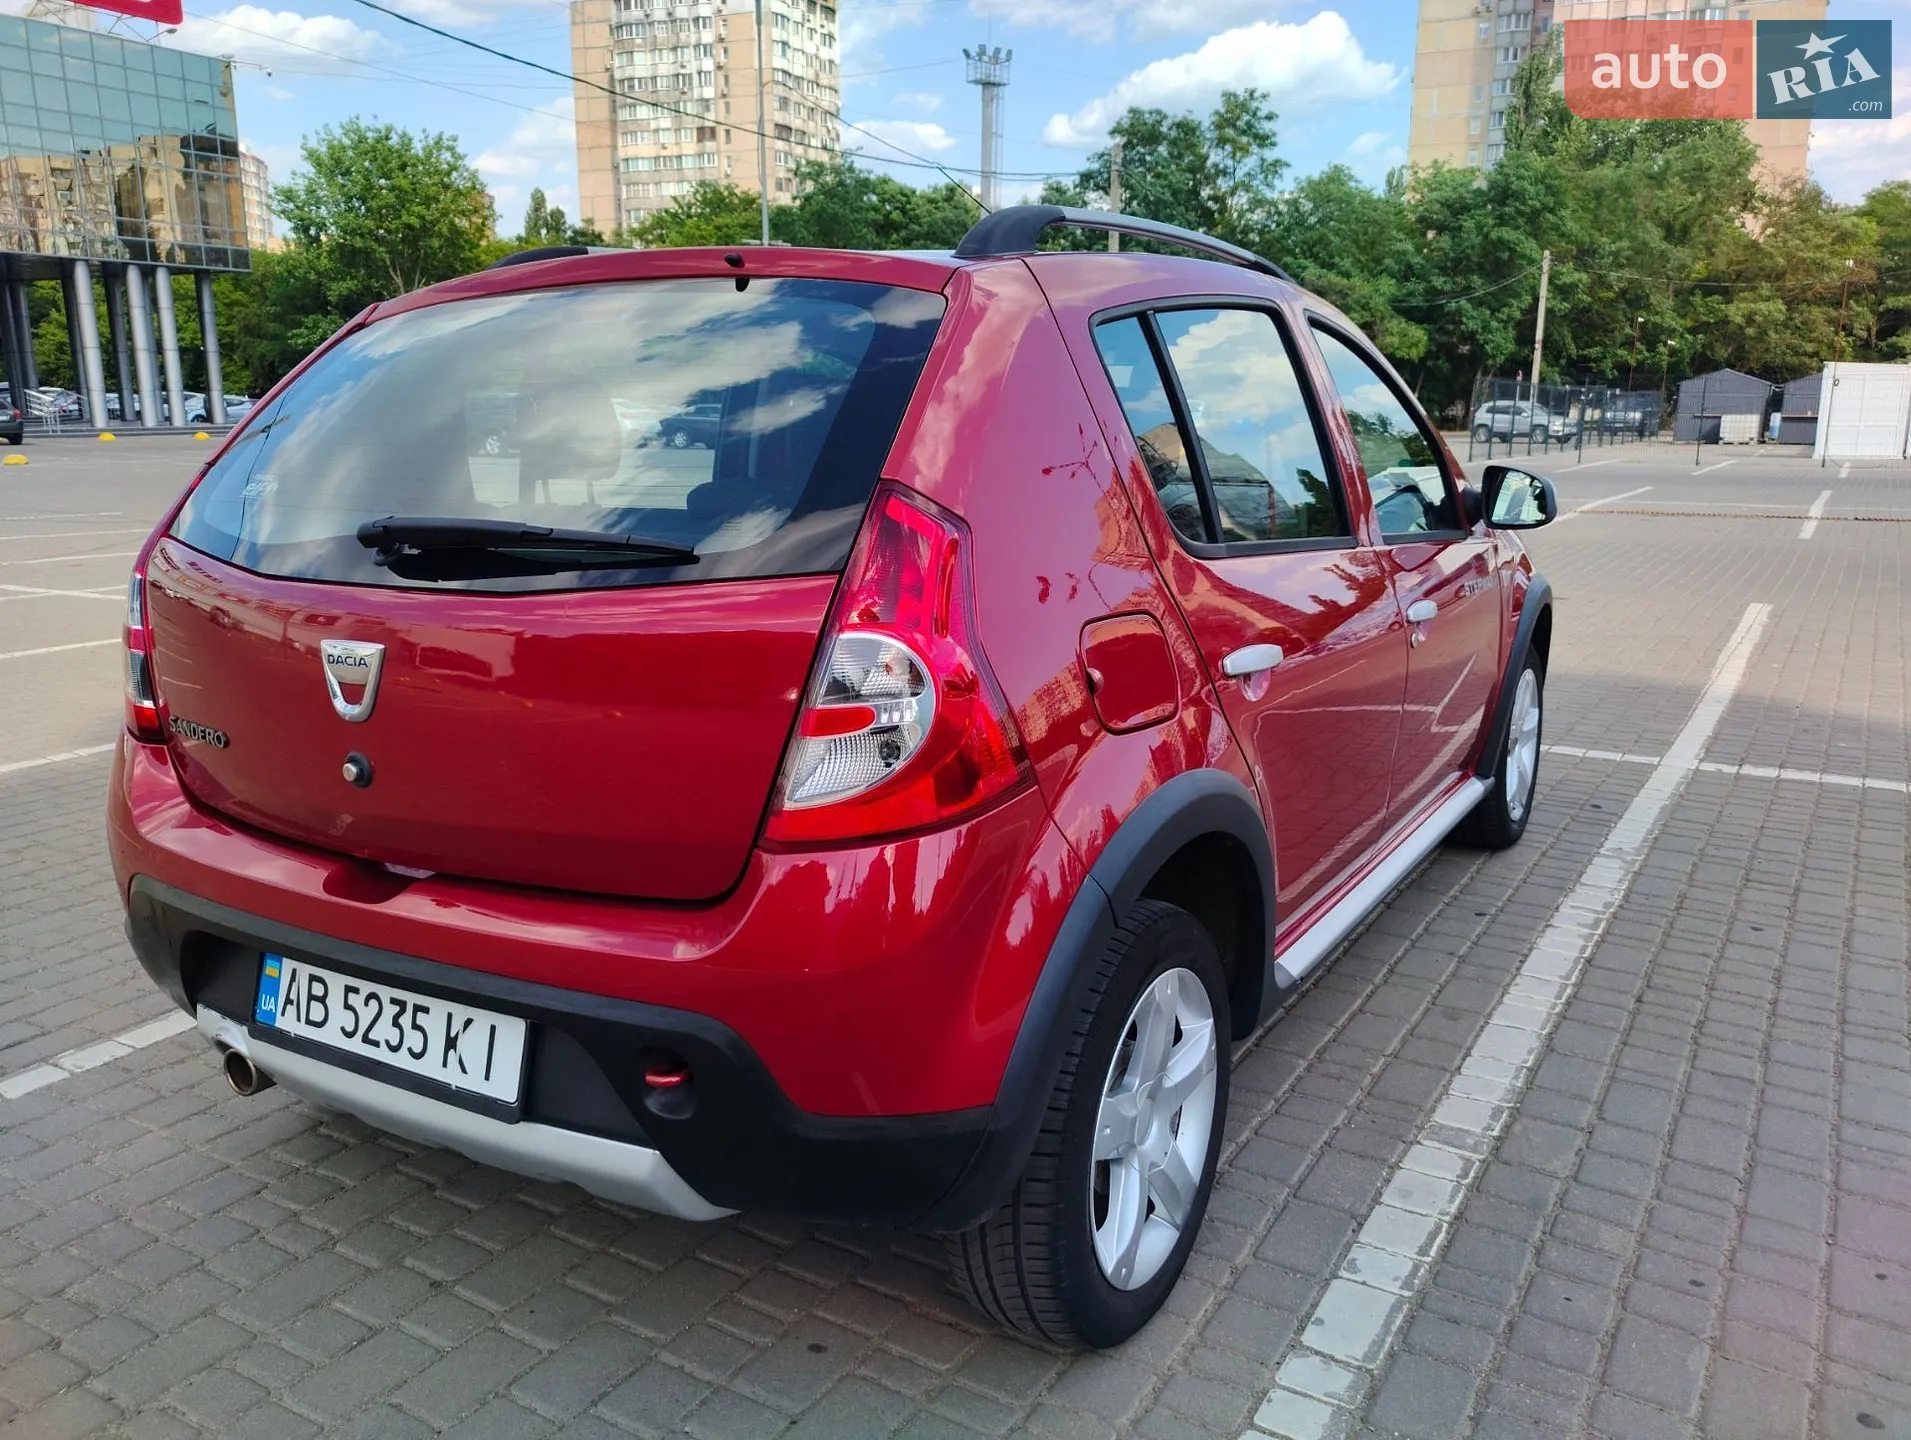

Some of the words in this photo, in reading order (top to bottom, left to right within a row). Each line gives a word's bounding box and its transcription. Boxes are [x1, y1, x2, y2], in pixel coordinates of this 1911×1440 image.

[327, 654, 368, 668] DACIA
[169, 716, 224, 748] SANDERO
[261, 993, 276, 1013] UA
[280, 967, 329, 1029] AB
[340, 984, 430, 1060] 5235
